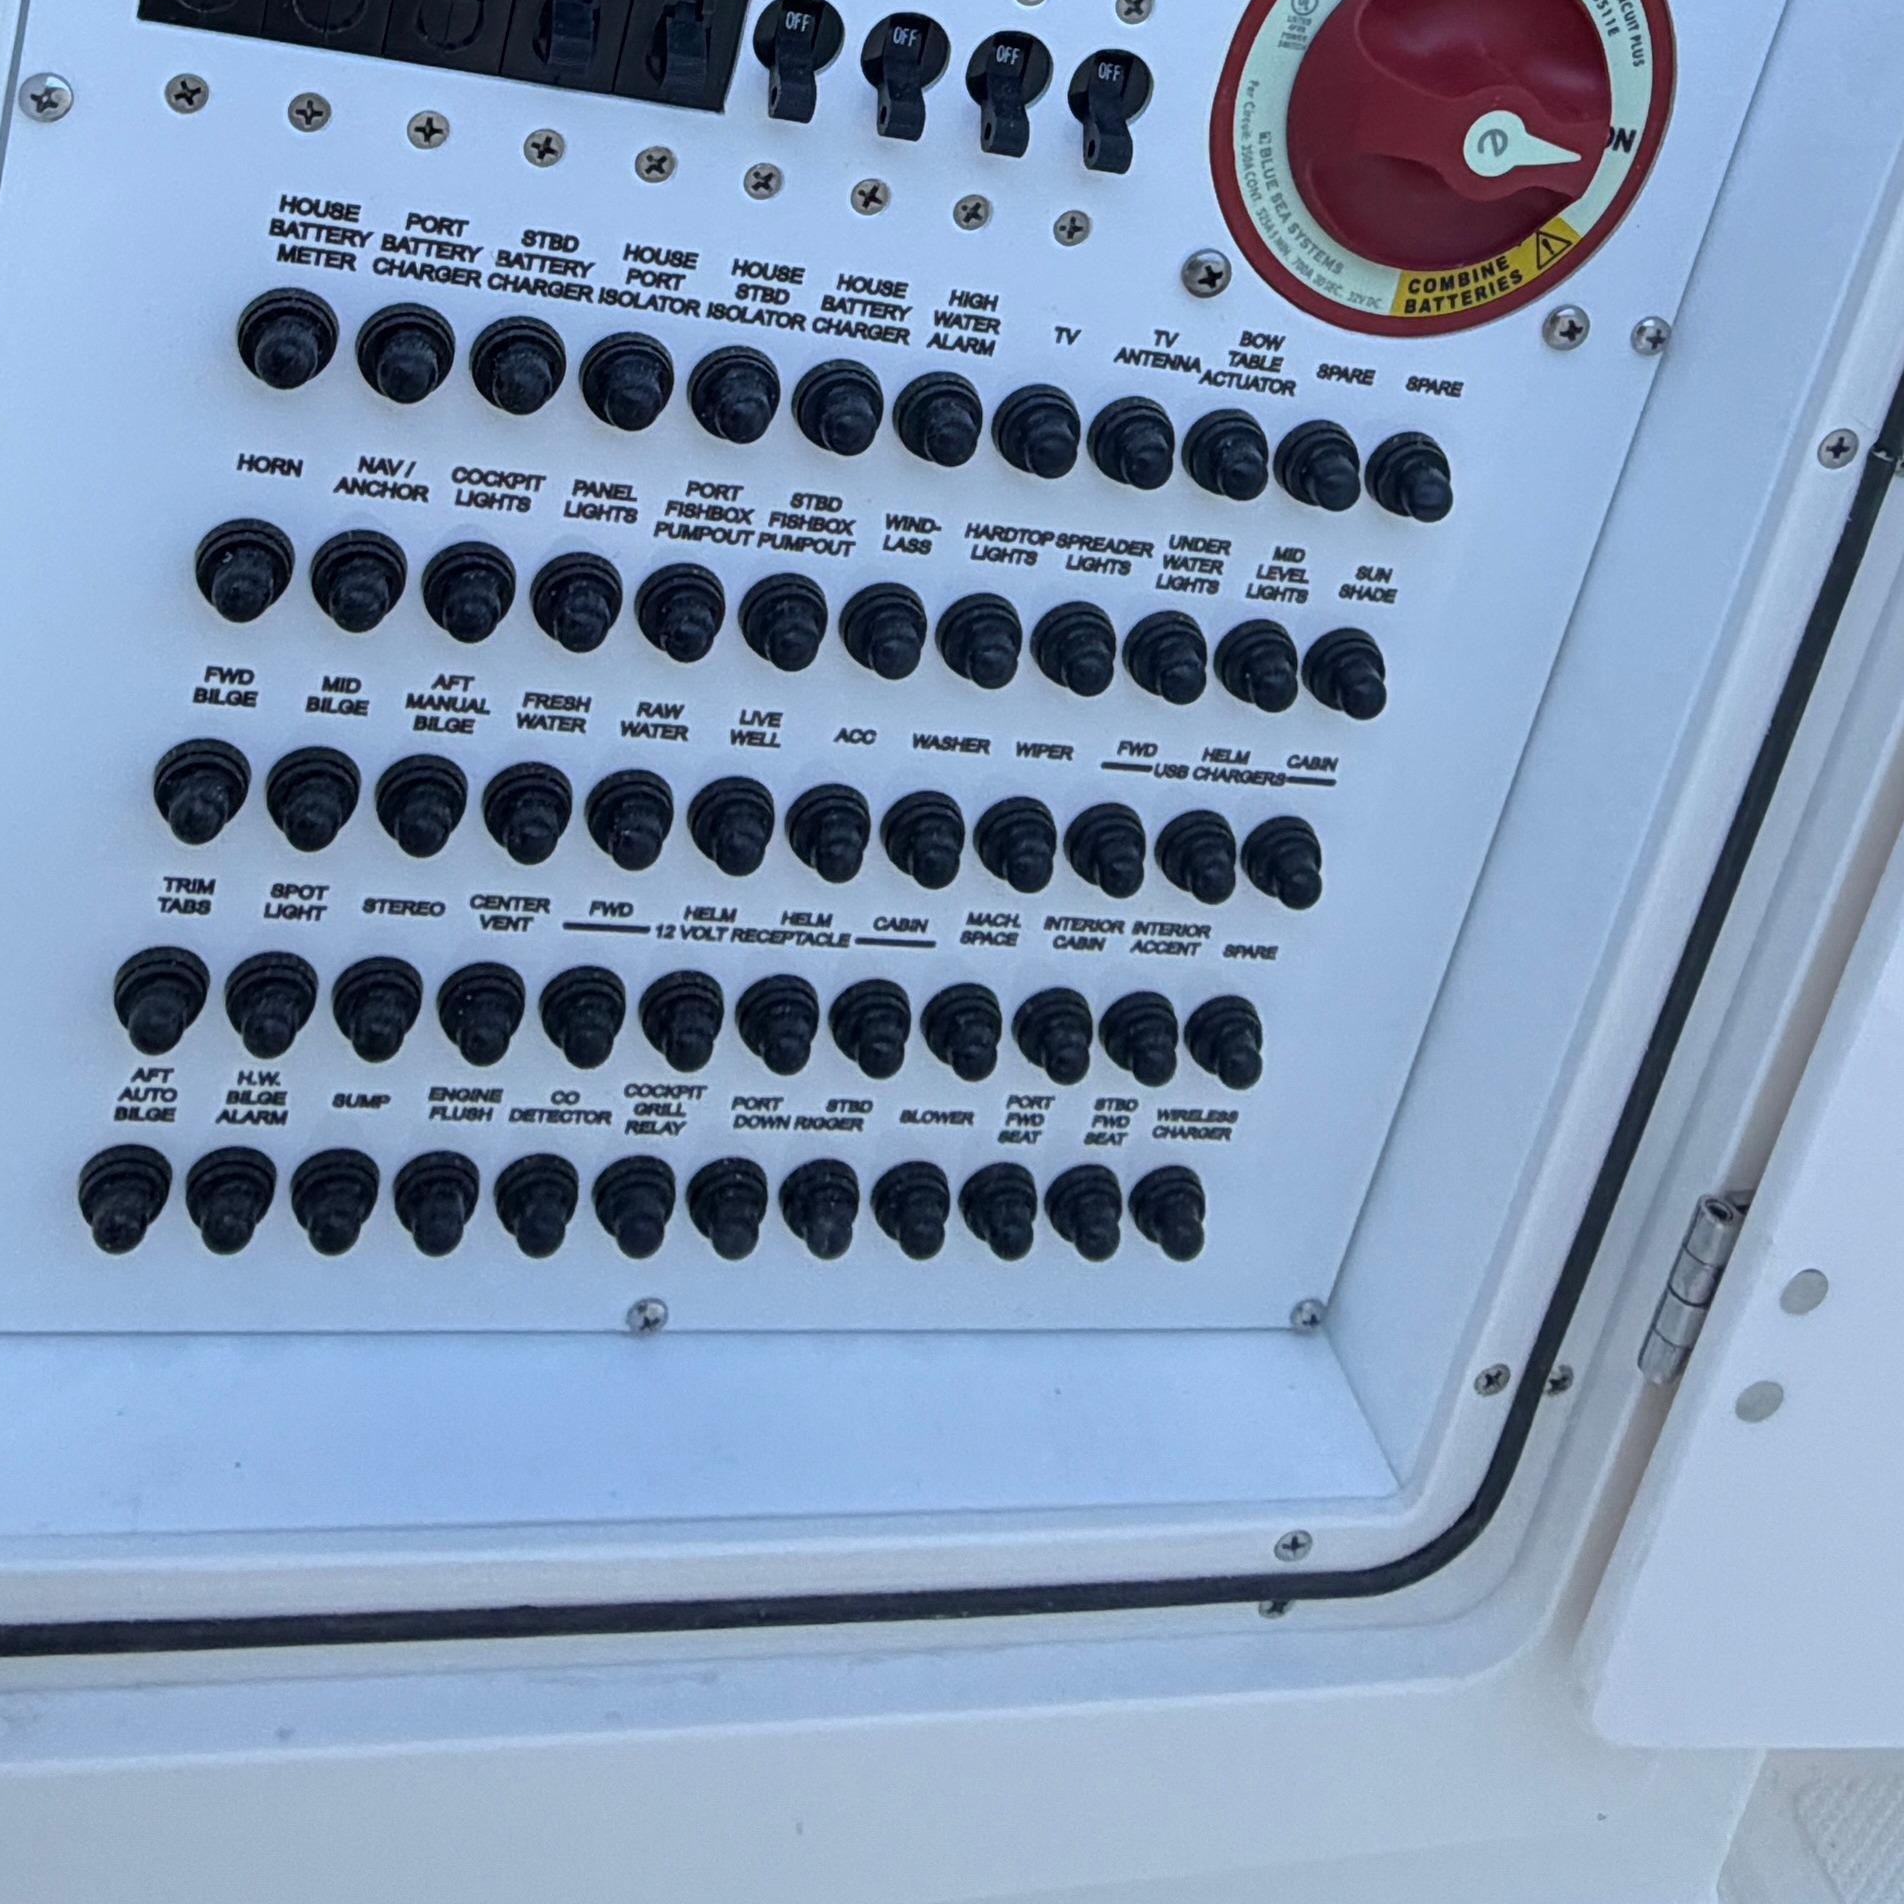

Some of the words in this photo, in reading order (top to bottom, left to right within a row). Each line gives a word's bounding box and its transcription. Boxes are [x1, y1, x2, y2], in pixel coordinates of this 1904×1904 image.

[279, 195, 360, 222] HOUSE
[269, 219, 374, 248] BATTERY
[406, 213, 469, 238] PORT
[382, 234, 483, 263] BATTERY
[521, 230, 579, 253] STBD
[277, 244, 357, 271] METER
[496, 251, 594, 279] BATTERY
[623, 244, 698, 270] HOUSE
[373, 257, 481, 288] CHARGER
[626, 269, 686, 291] PORT
[732, 258, 804, 285] HOUSE
[488, 273, 593, 303] CHARGER
[735, 284, 790, 305] STBD
[837, 274, 908, 299] HOUSE
[599, 287, 700, 318] ISOLATOR
[822, 296, 912, 322] BATTERY
[950, 290, 998, 311] HIGH
[707, 303, 806, 332] ISOLATOR
[934, 311, 1001, 335] WATER
[813, 318, 910, 345] CHARGER
[1054, 328, 1081, 345] TV
[1153, 330, 1179, 348] TV
[1240, 331, 1285, 351] BOW
[928, 335, 995, 357] ALARM
[1114, 348, 1201, 373] ANTENNA
[1230, 351, 1283, 372] TABLE
[1200, 370, 1296, 396] ACTUATOR
[1317, 364, 1375, 386] SPARE
[1406, 377, 1464, 397] SPARE
[237, 454, 303, 478] HORN
[334, 476, 428, 503] ANCHOR
[452, 467, 546, 492] COCKPIT
[455, 489, 531, 513] LIGHTS
[572, 480, 637, 502] PANEL
[687, 481, 743, 501] PORT
[564, 500, 637, 524] LIGHTS
[665, 501, 754, 525] FISHBOX
[791, 494, 842, 512] STBD
[769, 512, 855, 535] FISHBOX
[886, 514, 942, 534] WIND-
[654, 522, 754, 548] PUMPOUT
[966, 523, 1055, 546] HARDTOP
[758, 533, 856, 557] PUMPOUT
[883, 535, 932, 555] LASS
[1056, 534, 1153, 558] SPREADER
[1169, 535, 1231, 555] UNDER
[971, 545, 1038, 566] LIGHTS
[1066, 555, 1131, 575] LIGHTS
[1163, 555, 1224, 575] WATER
[1155, 574, 1220, 594] LIGHTS
[205, 666, 254, 685] FWD
[322, 676, 361, 693] MID
[432, 675, 474, 691] AFT
[407, 694, 490, 715] MANUAL
[522, 693, 591, 713] FRESH
[637, 702, 685, 719] RAW
[414, 716, 475, 735] BILGE
[516, 713, 587, 733] WATER
[740, 710, 783, 727] LIVE
[620, 721, 688, 741] WATER
[730, 730, 781, 748] WELL
[834, 728, 876, 745] ACC
[912, 734, 991, 754] WASHER
[1016, 742, 1073, 760] WIPER
[1117, 741, 1158, 757] FWD
[1202, 747, 1250, 765] HELM
[164, 876, 215, 895] TRIM
[271, 884, 329, 901] SPOT
[158, 897, 211, 915] TABS
[264, 903, 326, 921] LIGHT
[363, 898, 446, 916] STEREO
[470, 895, 550, 914] CENTER
[589, 901, 634, 917] FWD
[480, 915, 533, 932] VENT
[1132, 921, 1211, 939] INTERIOR
[656, 924, 676, 940] 12
[680, 925, 728, 942] VOLT
[730, 929, 850, 948] RECEPTACLE
[1130, 941, 1201, 956] ACCENT
[130, 1068, 174, 1084] AFT
[237, 1071, 280, 1087] H.W.
[118, 1087, 177, 1102] AUTO
[625, 1083, 707, 1100] COCKPIT
[732, 1096, 783, 1112] PORT
[216, 1109, 288, 1126] ALARM
[509, 1108, 612, 1125] DETECTOR
[900, 1110, 974, 1125] BLOWER
[1157, 1108, 1238, 1124] WIRELESS
[625, 1119, 685, 1135] RELAY
